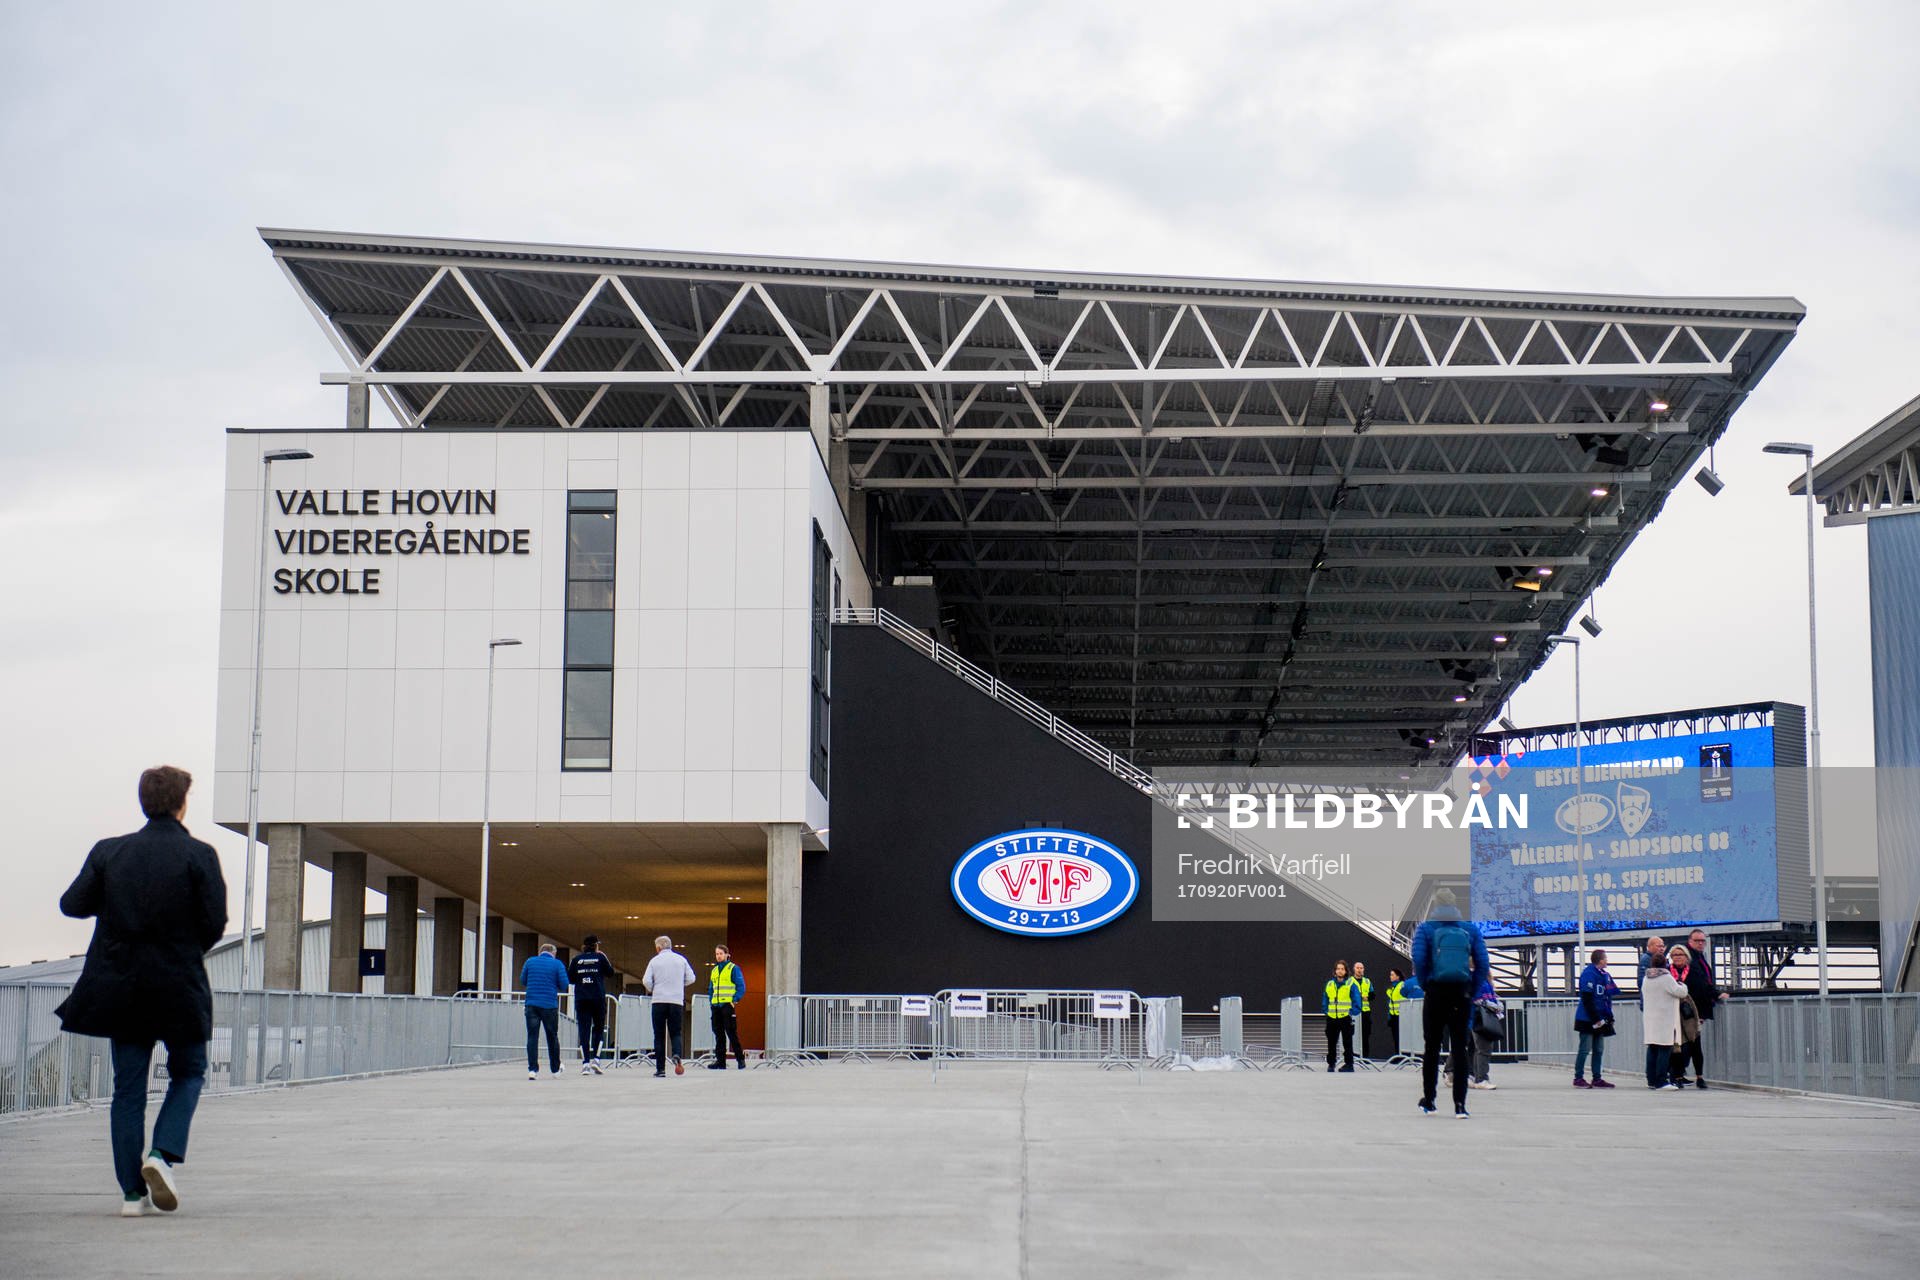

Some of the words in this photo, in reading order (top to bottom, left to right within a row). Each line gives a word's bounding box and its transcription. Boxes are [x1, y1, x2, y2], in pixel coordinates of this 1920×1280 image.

[276, 489, 380, 515] VALLE
[391, 489, 496, 515] HOVIN
[274, 521, 530, 555] VIDEREGÅENDE
[274, 568, 380, 594] SKOLE
[1535, 768, 1579, 788] NESTE
[995, 838, 1094, 857] STIFTET
[1610, 834, 1704, 859] SARPSBORG
[1708, 831, 1730, 851] 08
[1593, 872, 1617, 891] 20.
[1621, 866, 1704, 889] SEPTEMBER
[1607, 892, 1650, 911] 20:15
[1007, 910, 1081, 926] 29-7-13
[369, 955, 376, 969] 1
